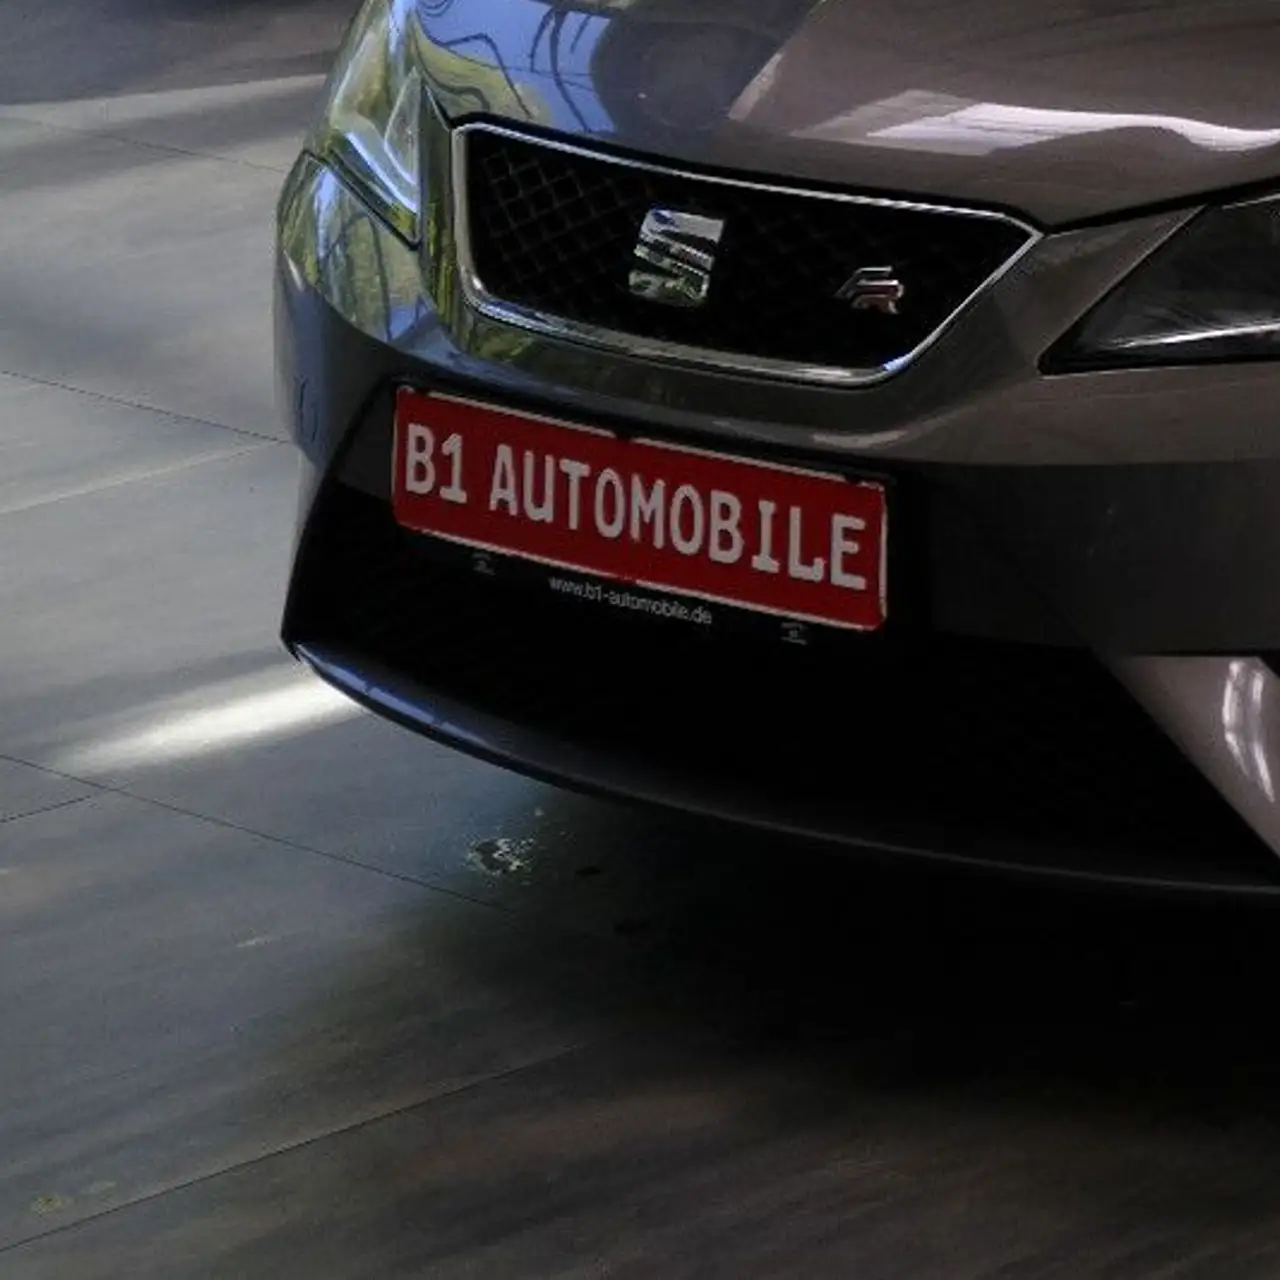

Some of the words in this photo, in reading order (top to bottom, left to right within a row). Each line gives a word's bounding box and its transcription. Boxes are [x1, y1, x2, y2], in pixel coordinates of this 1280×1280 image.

[405, 423, 468, 504] B1
[488, 443, 867, 591] AUTOMOBILE
[548, 575, 713, 625] www.b1-automobile.de
